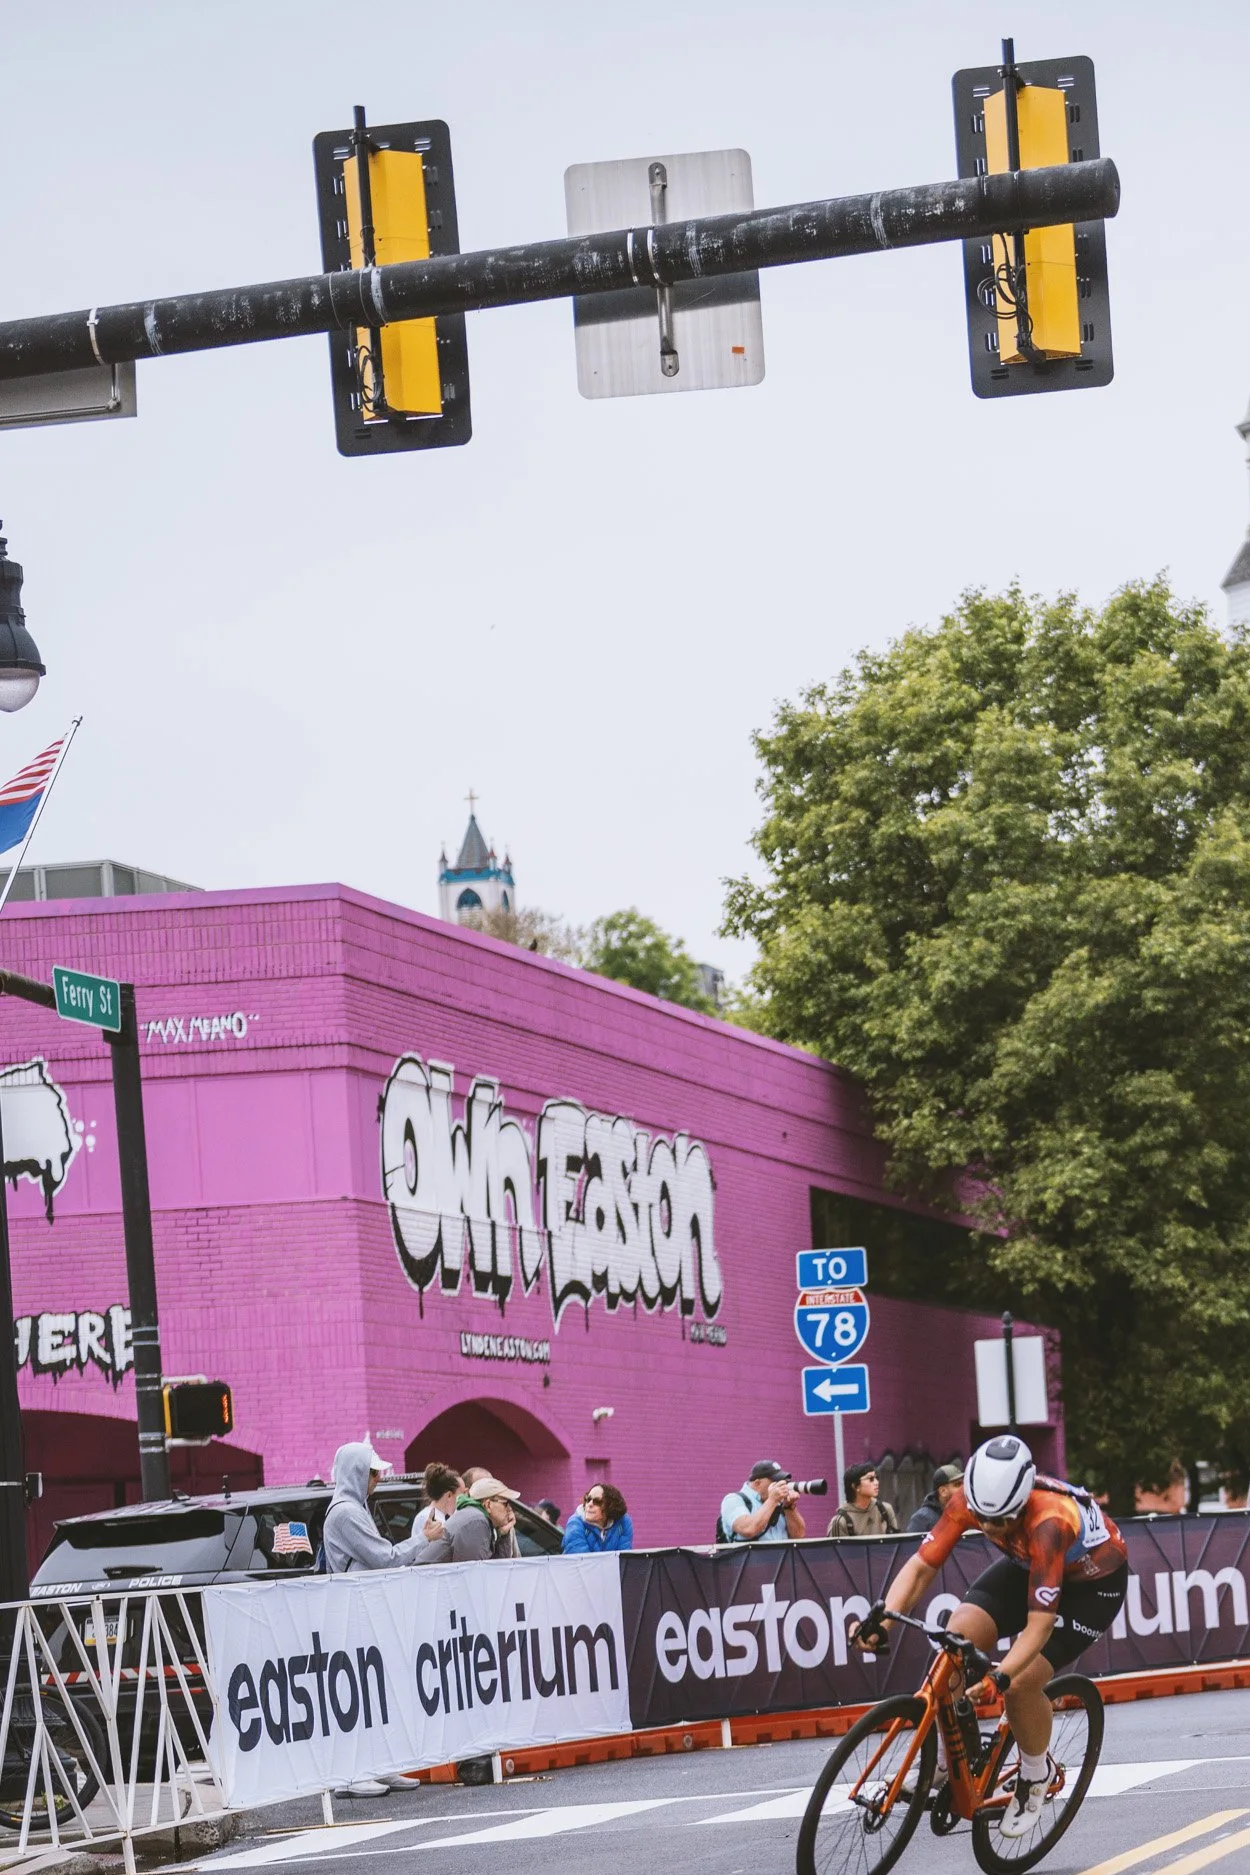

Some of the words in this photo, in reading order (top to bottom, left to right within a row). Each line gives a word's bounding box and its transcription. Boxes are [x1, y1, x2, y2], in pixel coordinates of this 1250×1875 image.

[61, 976, 94, 1018] Ferry
[99, 985, 112, 1015] St
[812, 1256, 848, 1281] TO
[805, 1293, 857, 1306] INTERSTATE
[806, 1311, 858, 1348] 78
[30, 1583, 83, 1597] EASTON
[128, 1575, 183, 1589] POLICE
[656, 1583, 877, 1684] easton
[227, 1631, 389, 1752] easton
[416, 1602, 619, 1717] criterium
